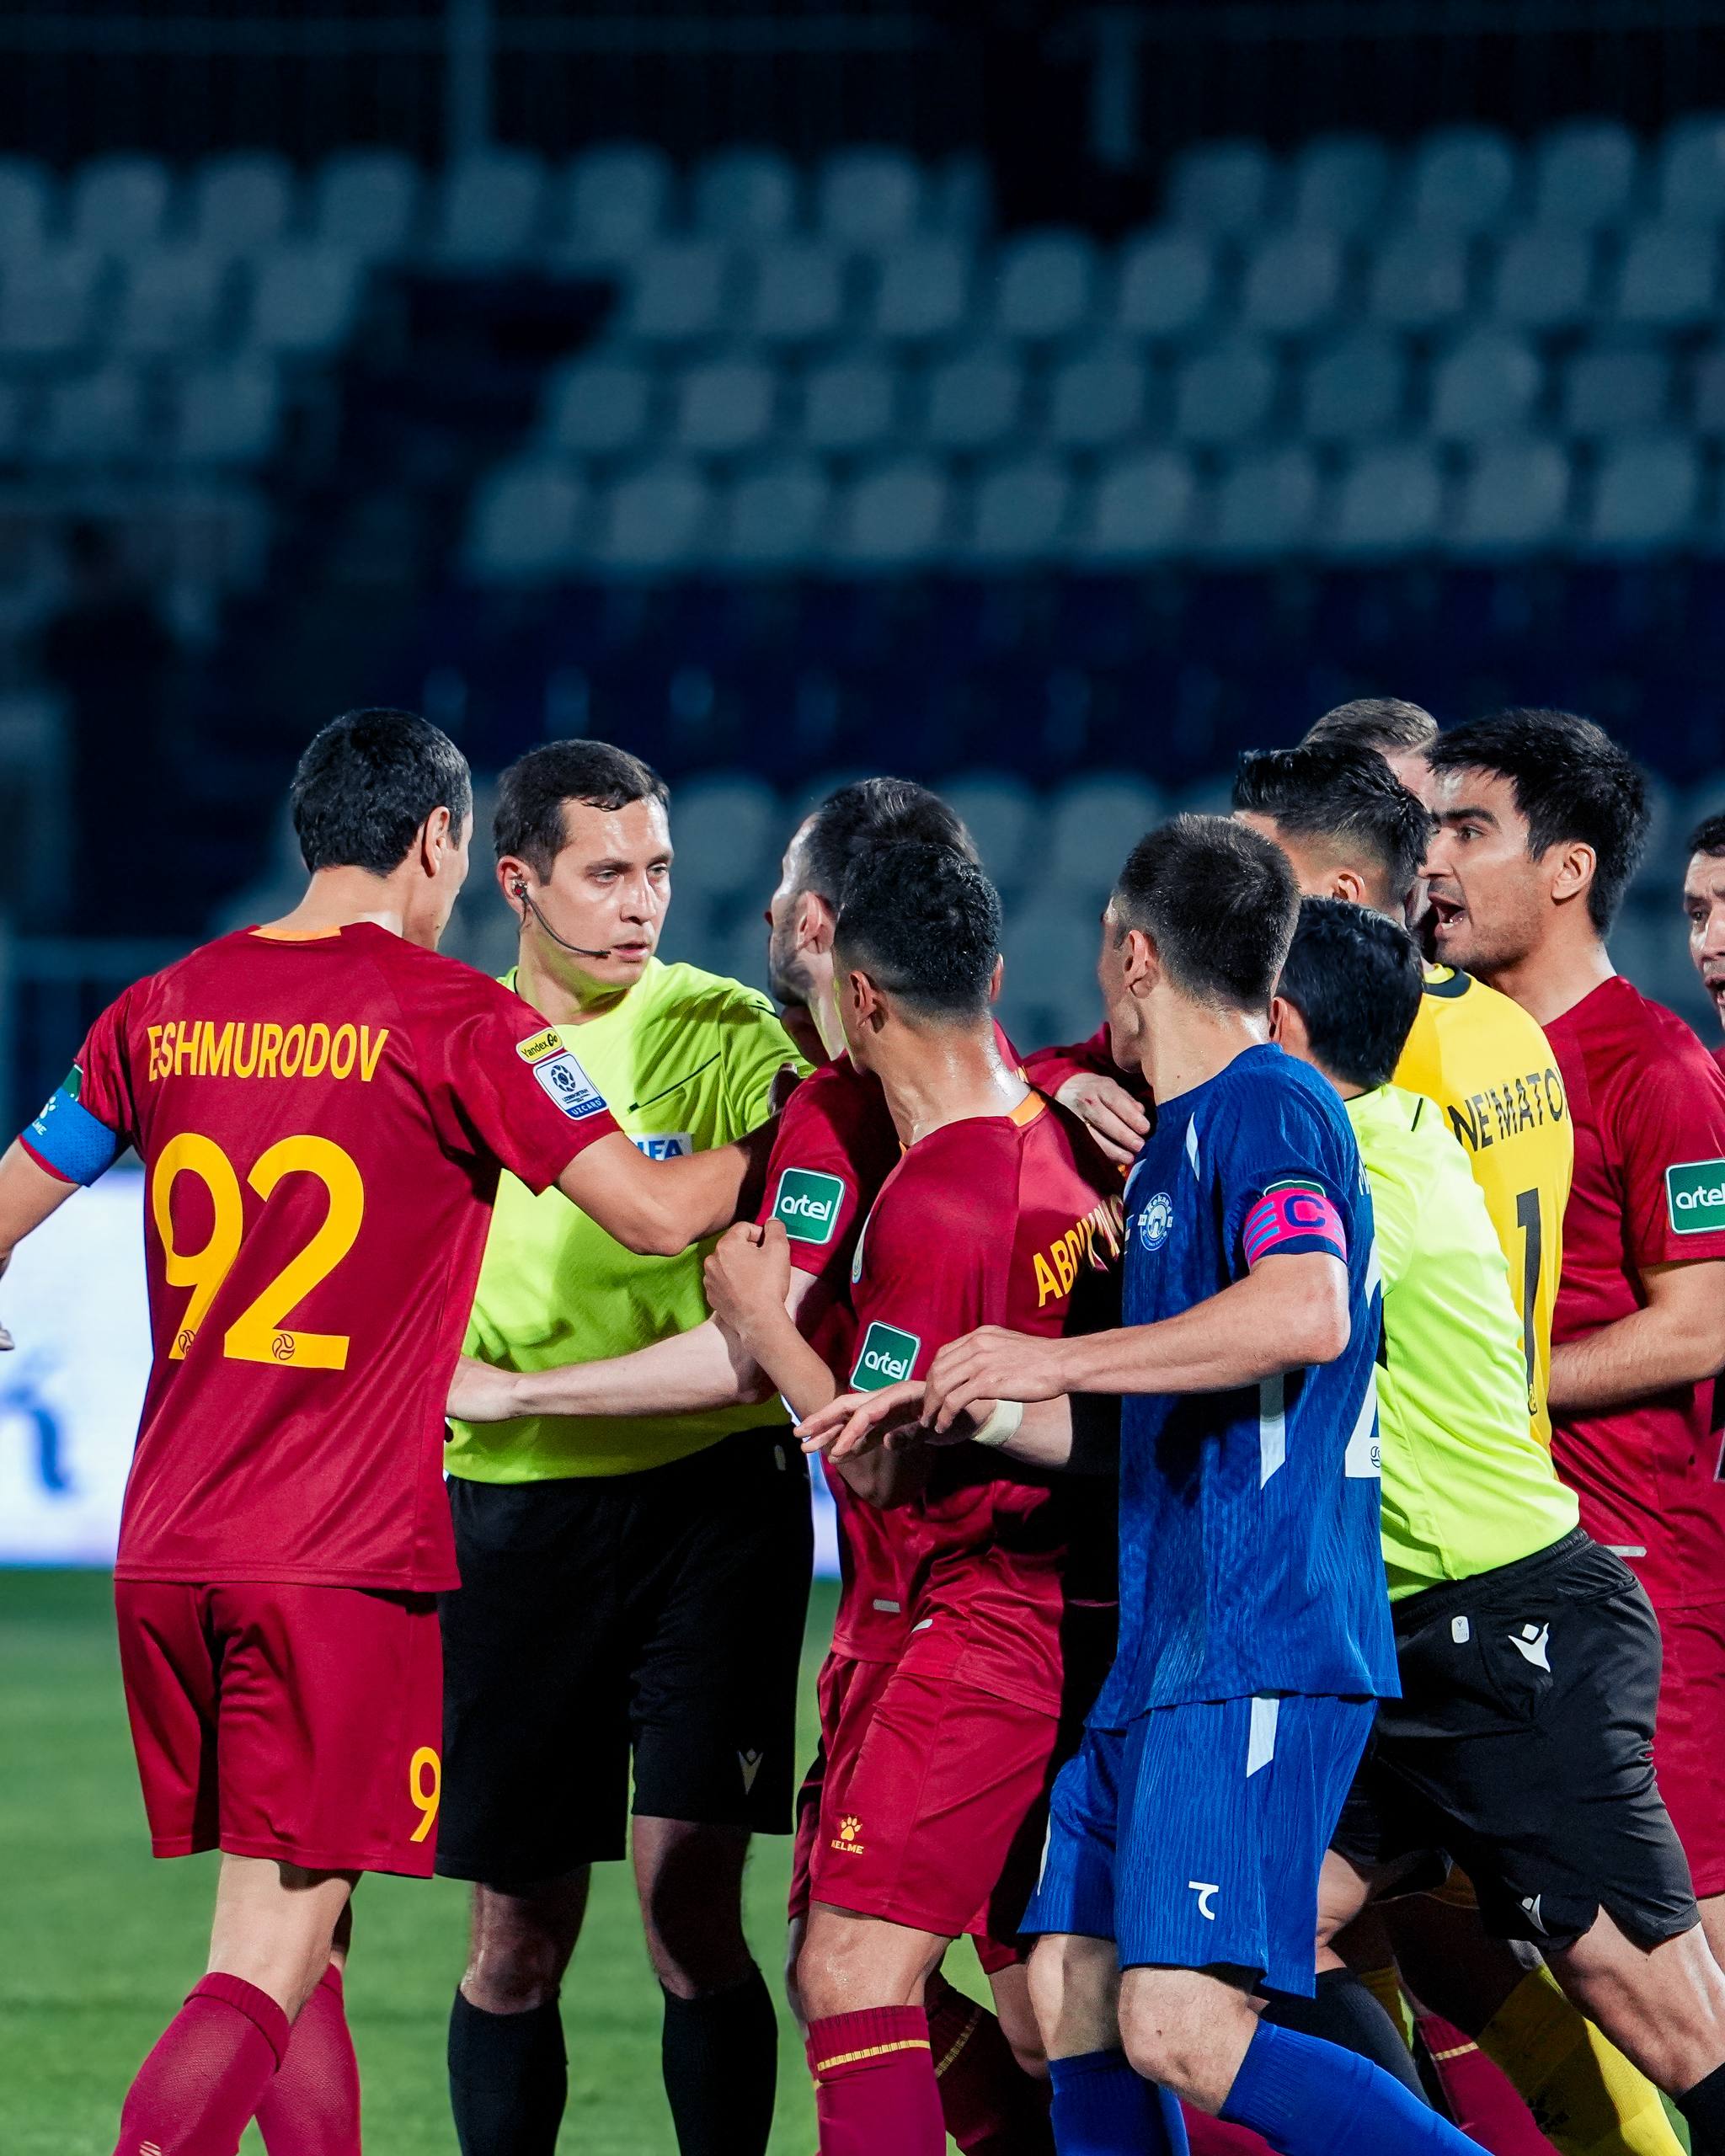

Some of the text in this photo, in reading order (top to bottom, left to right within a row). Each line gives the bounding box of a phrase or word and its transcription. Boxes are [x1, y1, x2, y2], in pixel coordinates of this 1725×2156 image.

[147, 1021, 389, 1082] ESHMURODOV
[521, 1041, 549, 1058] Yandex
[1447, 1067, 1568, 1152] NE'MATO
[780, 1194, 832, 1221] artel
[1284, 1195, 1326, 1229] C
[1675, 1182, 1725, 1209] artel
[152, 1133, 365, 1370] 92
[1516, 1187, 1541, 1417] 1
[864, 1350, 909, 1380] artel
[409, 1746, 441, 1843] 9
[830, 1839, 864, 1854] KELME
